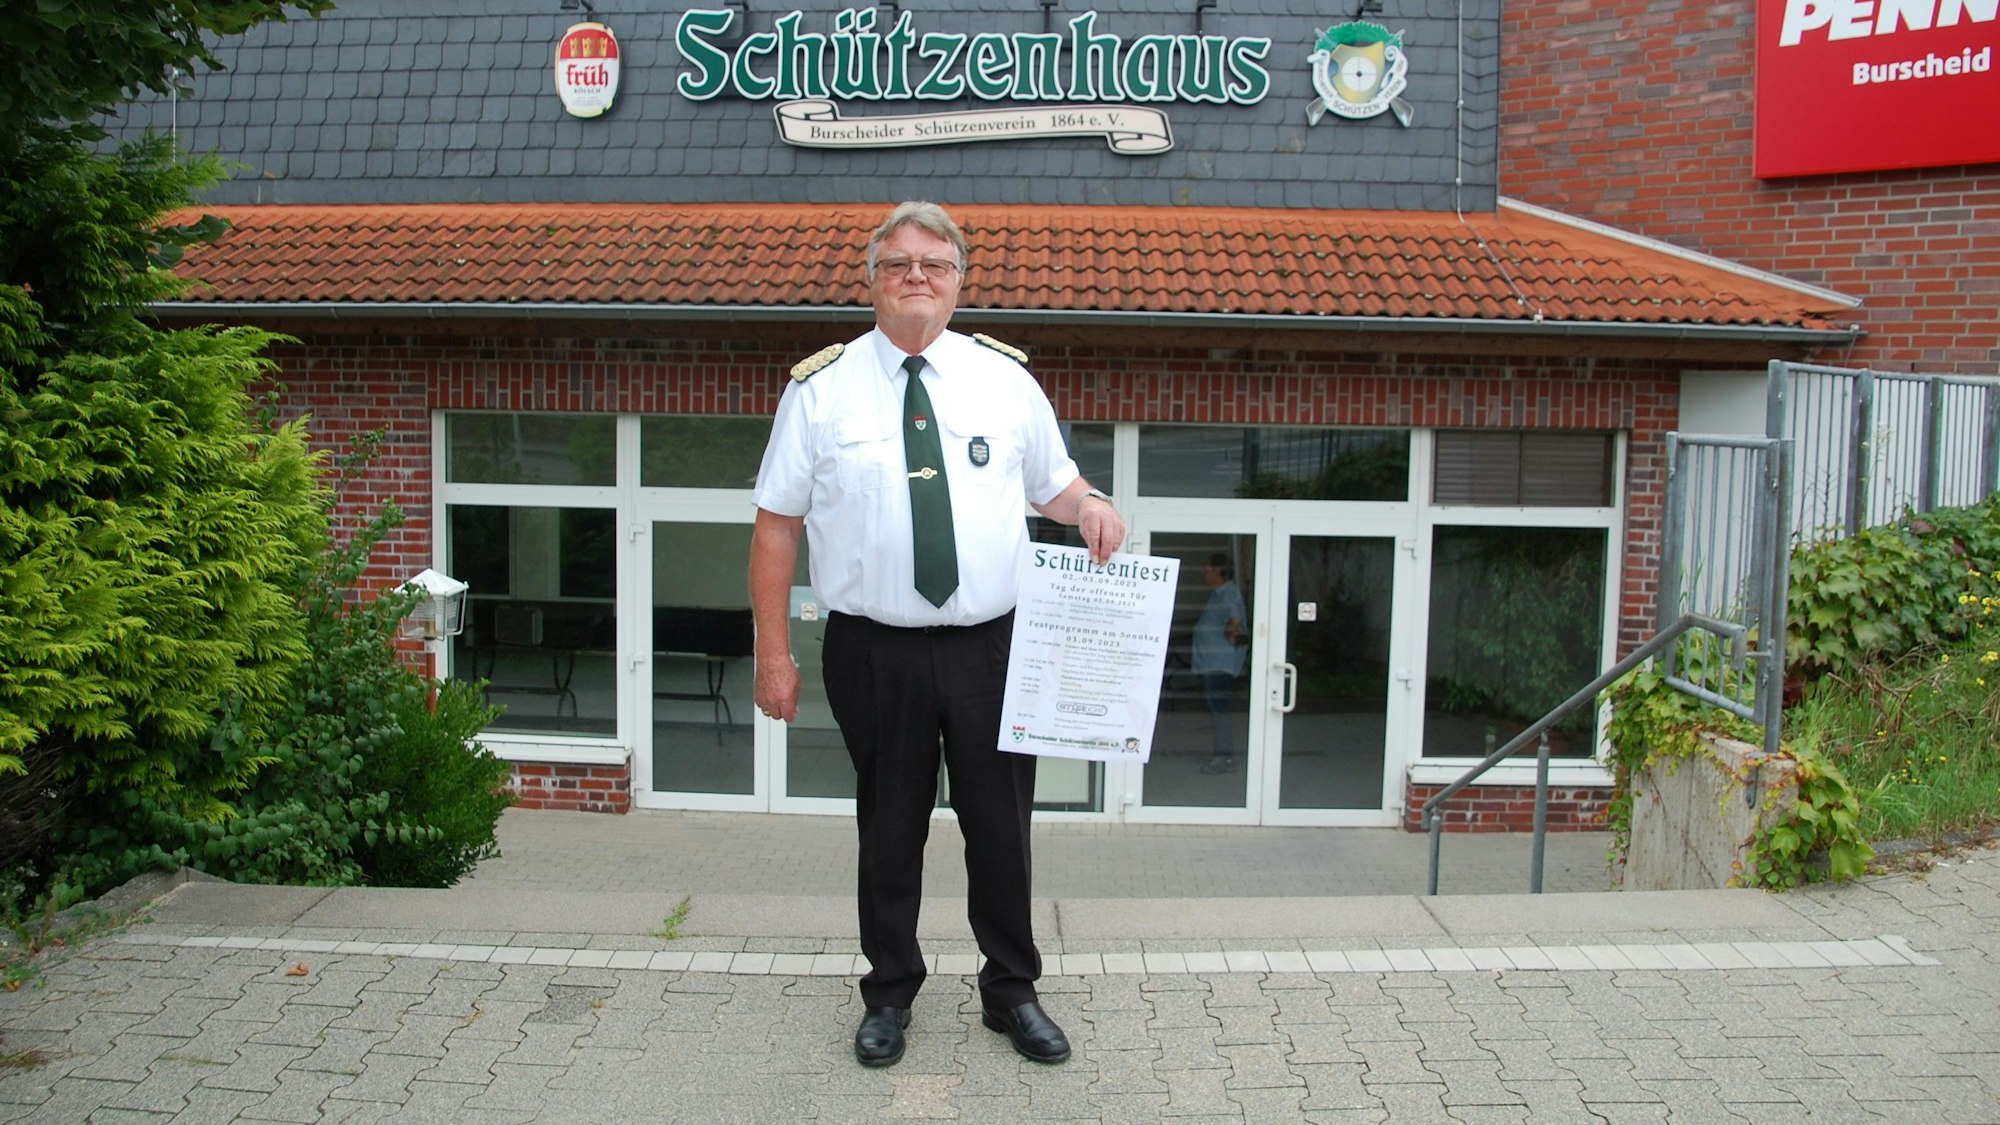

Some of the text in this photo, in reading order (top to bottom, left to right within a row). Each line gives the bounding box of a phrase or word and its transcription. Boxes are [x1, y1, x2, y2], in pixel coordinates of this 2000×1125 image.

[676, 8, 1271, 105] Schützenhaus
[1852, 46, 1991, 86] Burscheid
[566, 62, 609, 88] früh
[809, 124, 905, 140] Burscheider
[914, 116, 1036, 137] Schützenverein
[1050, 113, 1085, 128] 1864
[1050, 583, 1147, 600] Tag der offenen Tür
[1062, 573, 1137, 588] 02.-03.09.2023
[1058, 593, 1091, 603] Samstag
[1029, 620, 1160, 643] Festprogramm am Sonntag
[1066, 636, 1121, 647] 03.09.2023
